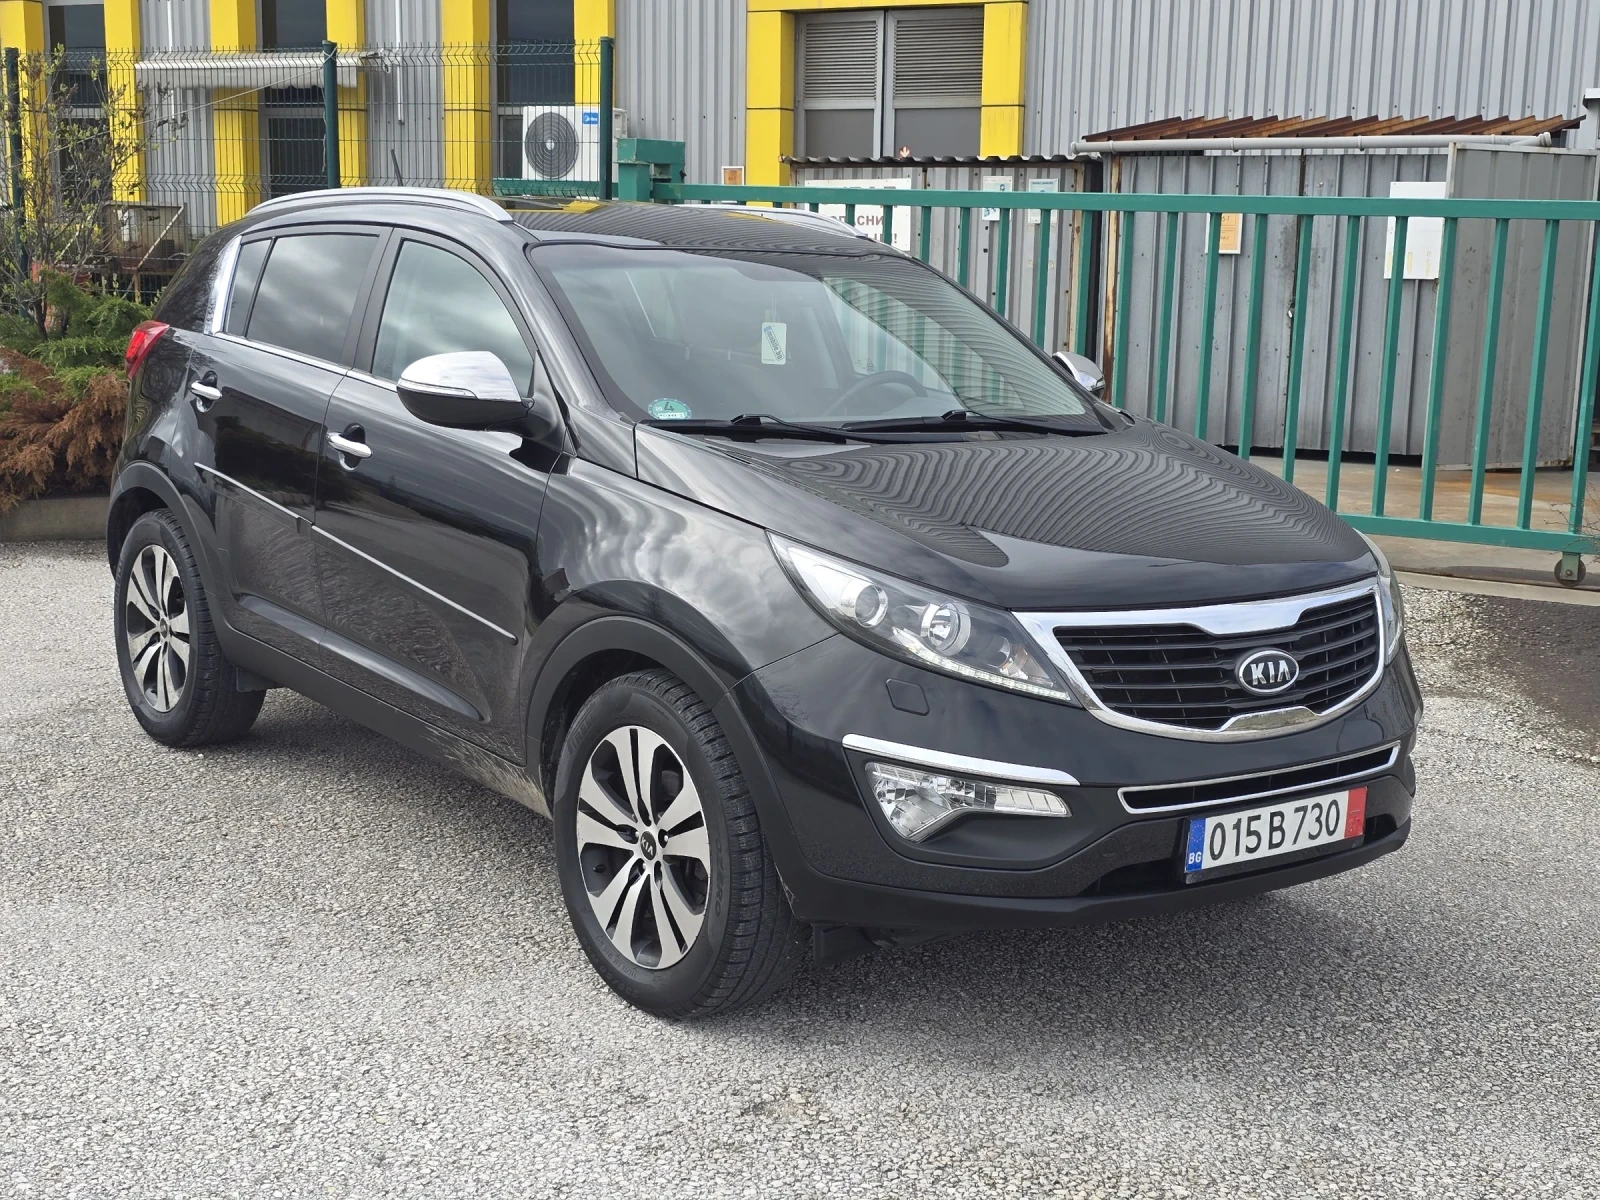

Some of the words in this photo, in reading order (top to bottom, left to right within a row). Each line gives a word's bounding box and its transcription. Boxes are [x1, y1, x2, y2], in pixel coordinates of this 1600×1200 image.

[767, 331, 783, 359] mobile.bg
[663, 401, 675, 412] 4
[1250, 659, 1291, 686] KIA
[1209, 799, 1341, 860] 015B730
[641, 836, 654, 856] KIA
[1188, 851, 1202, 865] BG
